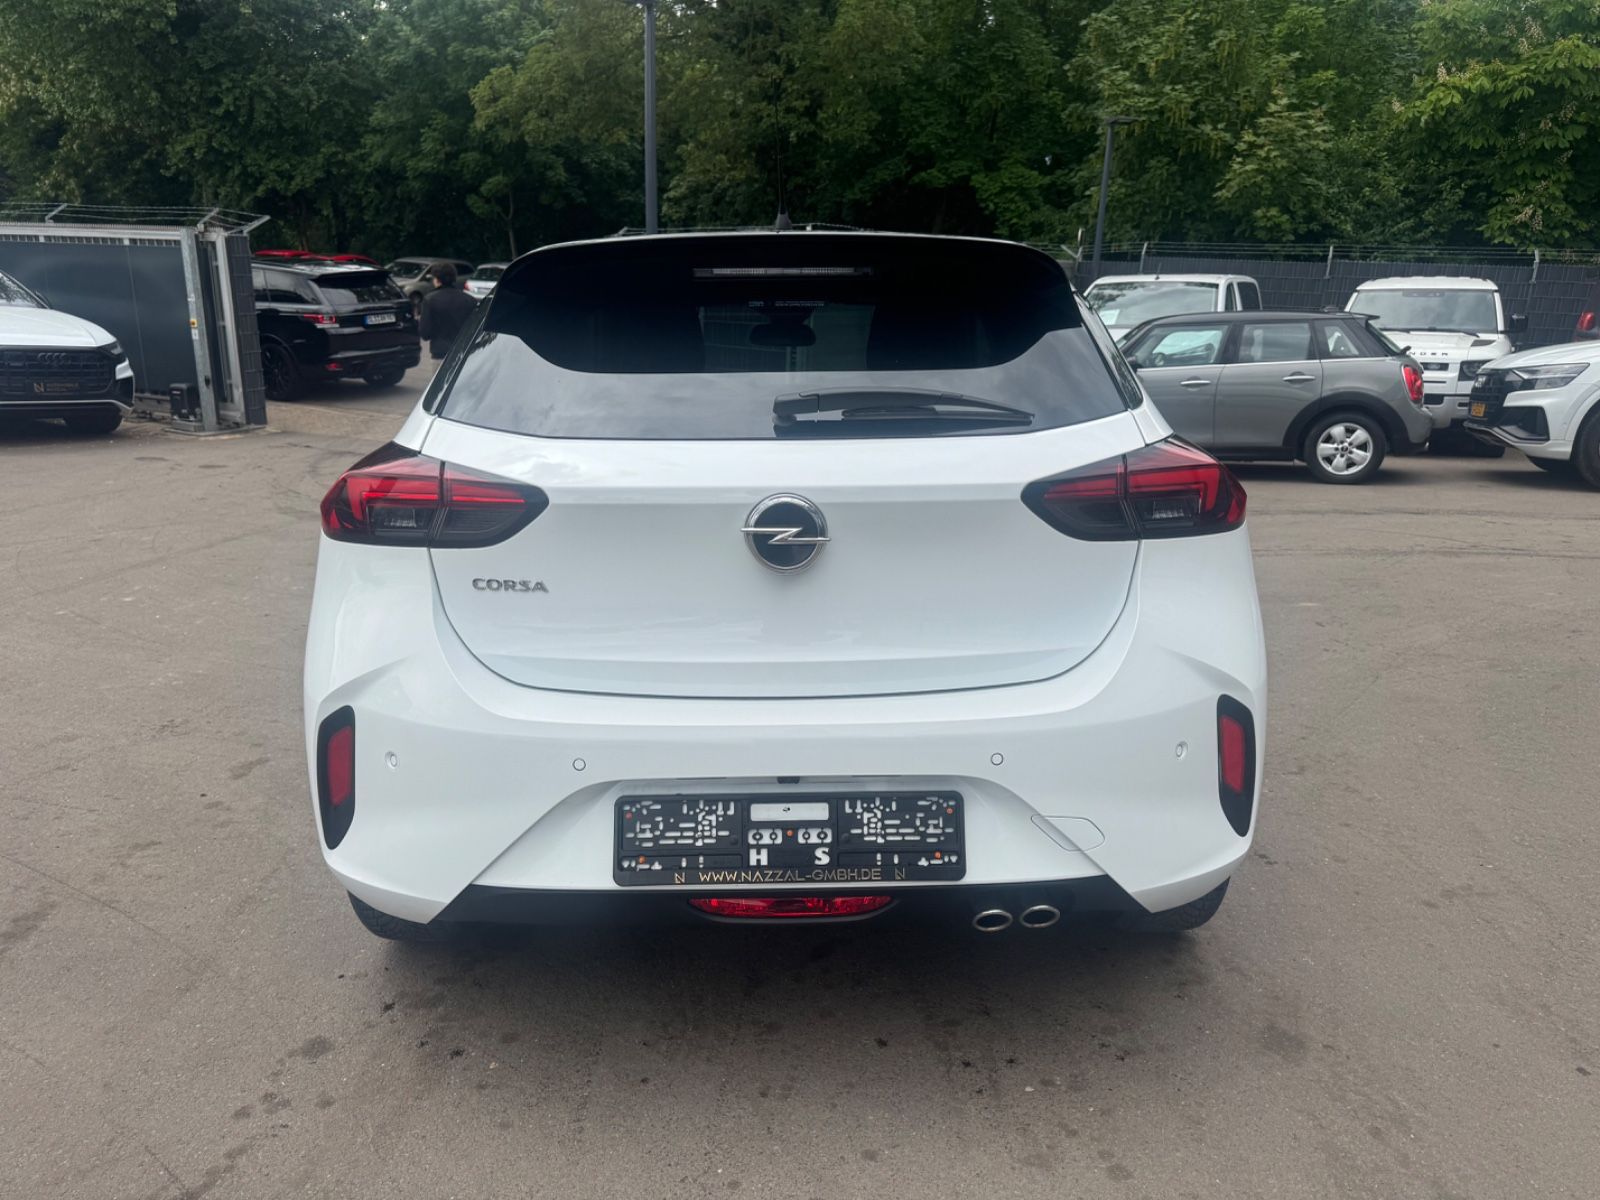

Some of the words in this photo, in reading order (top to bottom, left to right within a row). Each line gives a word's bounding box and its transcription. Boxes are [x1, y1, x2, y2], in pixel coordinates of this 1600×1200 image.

[472, 577, 549, 593] CORSA
[749, 848, 768, 866] H
[814, 847, 830, 865] S
[698, 868, 881, 883] WWW.NAZZAL-GMBH.DE
